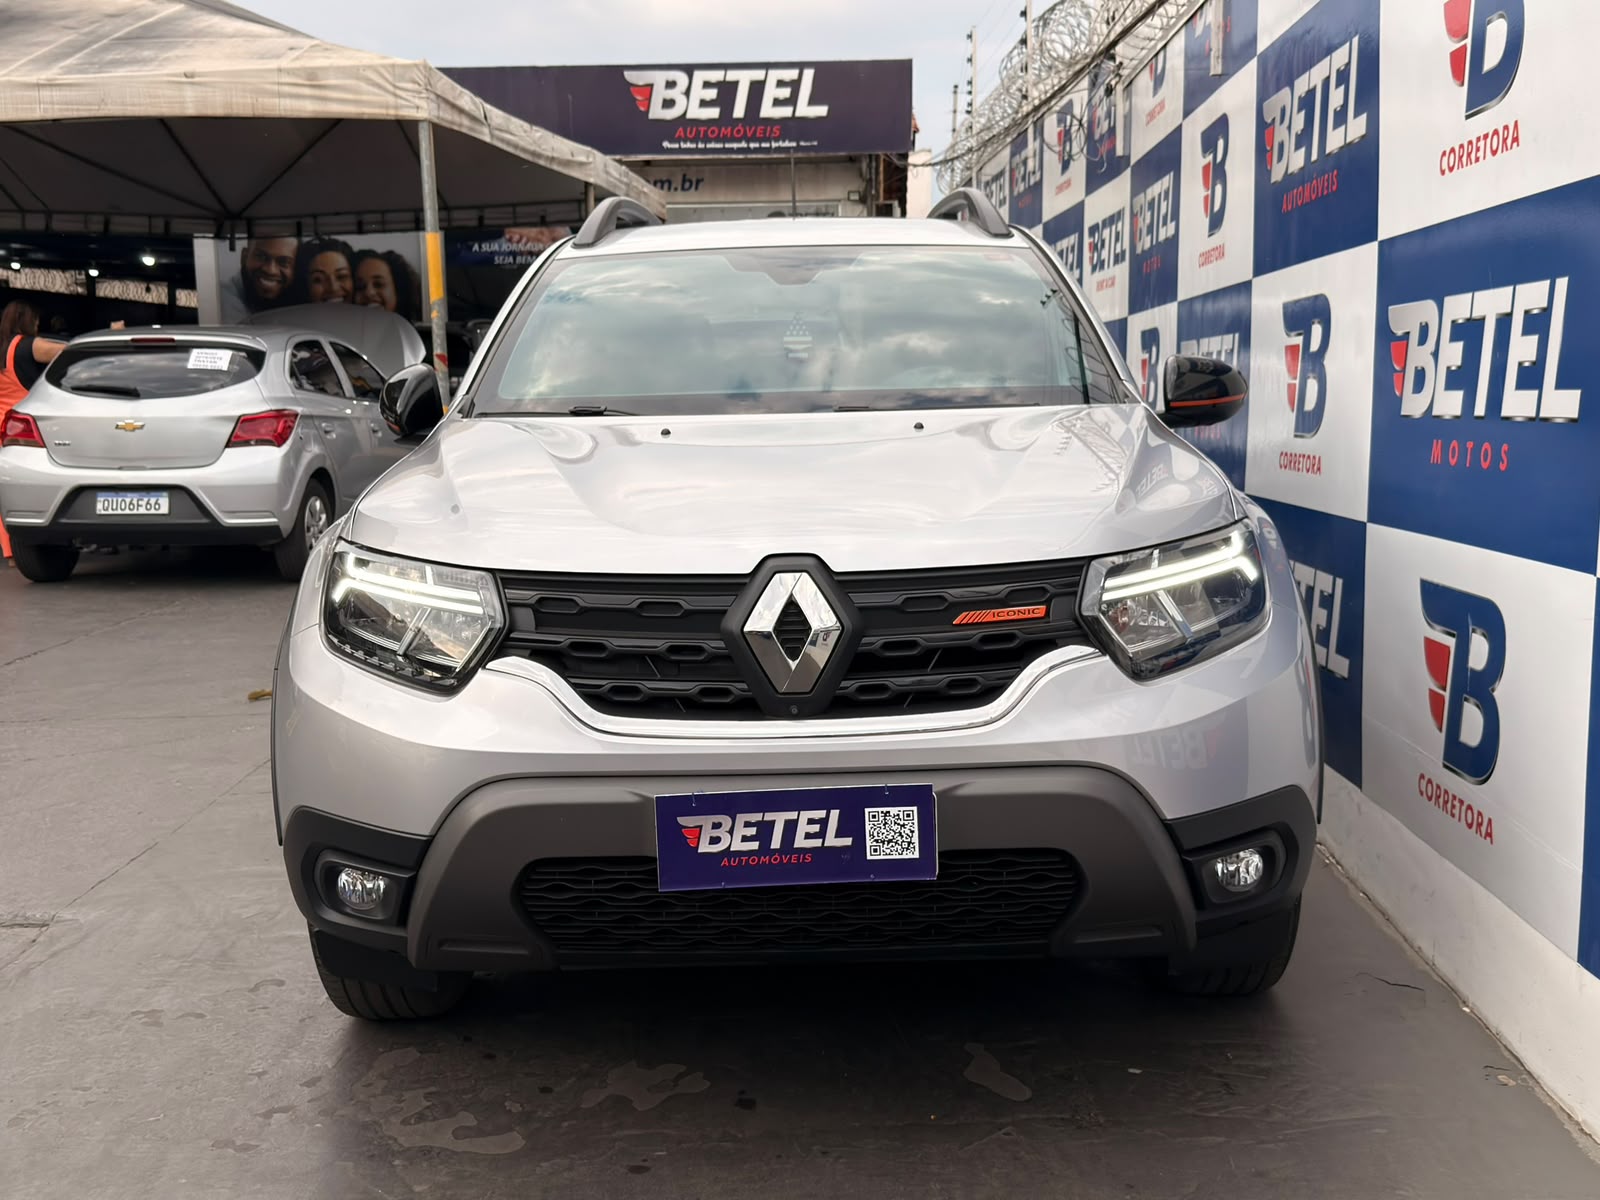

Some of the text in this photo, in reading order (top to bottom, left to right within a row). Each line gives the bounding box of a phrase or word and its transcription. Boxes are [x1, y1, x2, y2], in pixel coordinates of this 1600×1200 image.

[624, 68, 829, 120] BETEL
[1263, 35, 1367, 184] BETEL
[674, 124, 781, 139] AUTOMÓVEIS
[1439, 120, 1520, 176] CORRETORA
[1200, 112, 1229, 238] B
[1282, 170, 1338, 214] AUTOMÓVEIS
[1133, 170, 1175, 255] BETEL
[481, 243, 499, 252] SUA
[494, 256, 514, 265] SEJA
[1088, 206, 1126, 275] BETEL
[1282, 293, 1332, 438] B
[1388, 276, 1582, 423] BETEL
[1278, 452, 1322, 476] CORRETORA
[1430, 440, 1509, 472] MOTOS
[992, 608, 1041, 619] ICONIC
[1420, 577, 1506, 786] B
[677, 809, 853, 853] BETEL
[1417, 772, 1494, 845] CORRETORA
[721, 852, 813, 867] AUTOMÓVEIS
